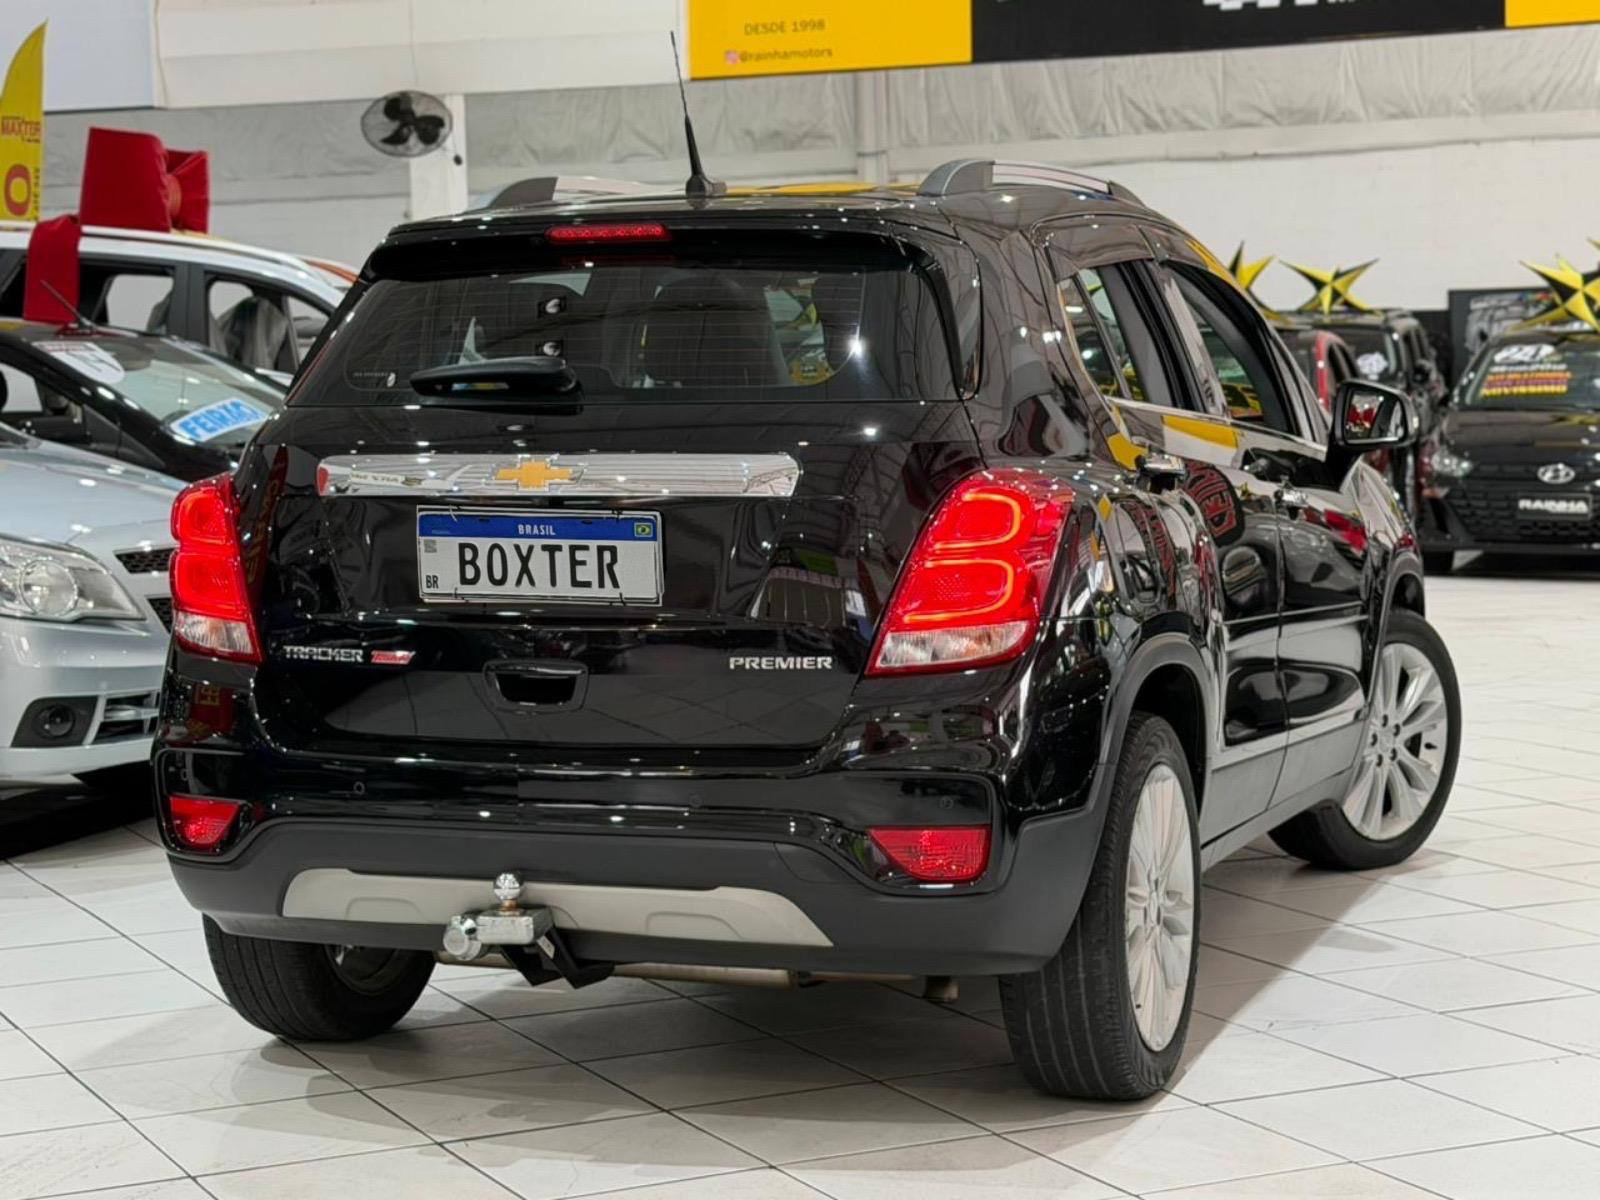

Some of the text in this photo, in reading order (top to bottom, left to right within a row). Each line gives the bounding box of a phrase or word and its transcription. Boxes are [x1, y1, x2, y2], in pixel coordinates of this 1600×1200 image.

[743, 18, 826, 36] DESDE 1998
[517, 523, 557, 537] BRASIL
[457, 542, 621, 590] BOXTER
[425, 574, 440, 590] BR
[283, 645, 364, 663] TRACKER
[728, 656, 833, 670] PREMIER
